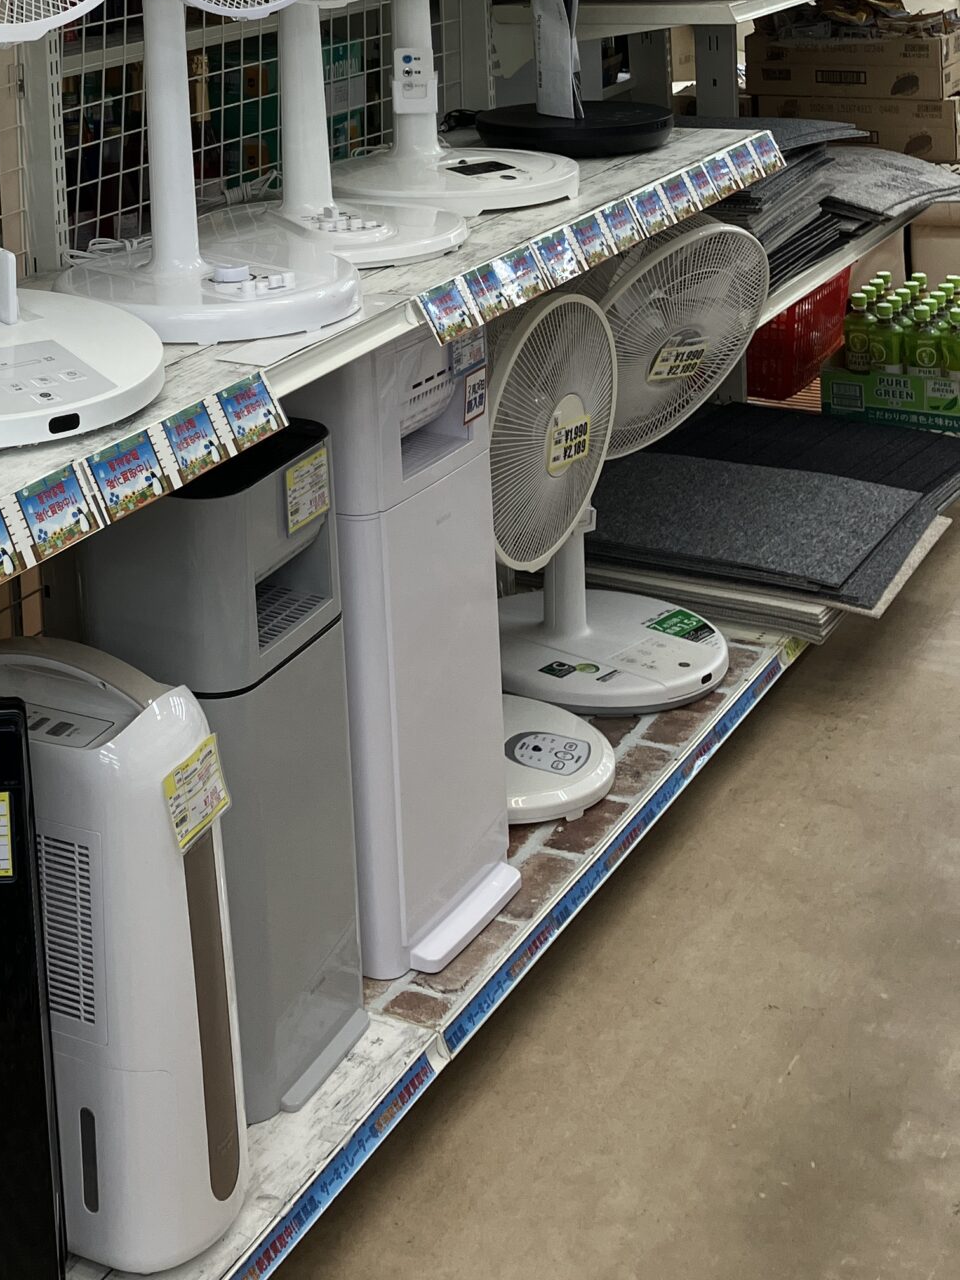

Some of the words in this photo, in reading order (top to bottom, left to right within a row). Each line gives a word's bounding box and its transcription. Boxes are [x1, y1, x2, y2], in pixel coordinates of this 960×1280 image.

[878, 377, 909, 389] PURE
[933, 380, 952, 388] PURE
[875, 389, 914, 400] GREEN
[565, 422, 588, 443] ¥1,990
[563, 439, 586, 460] ¥2,189
